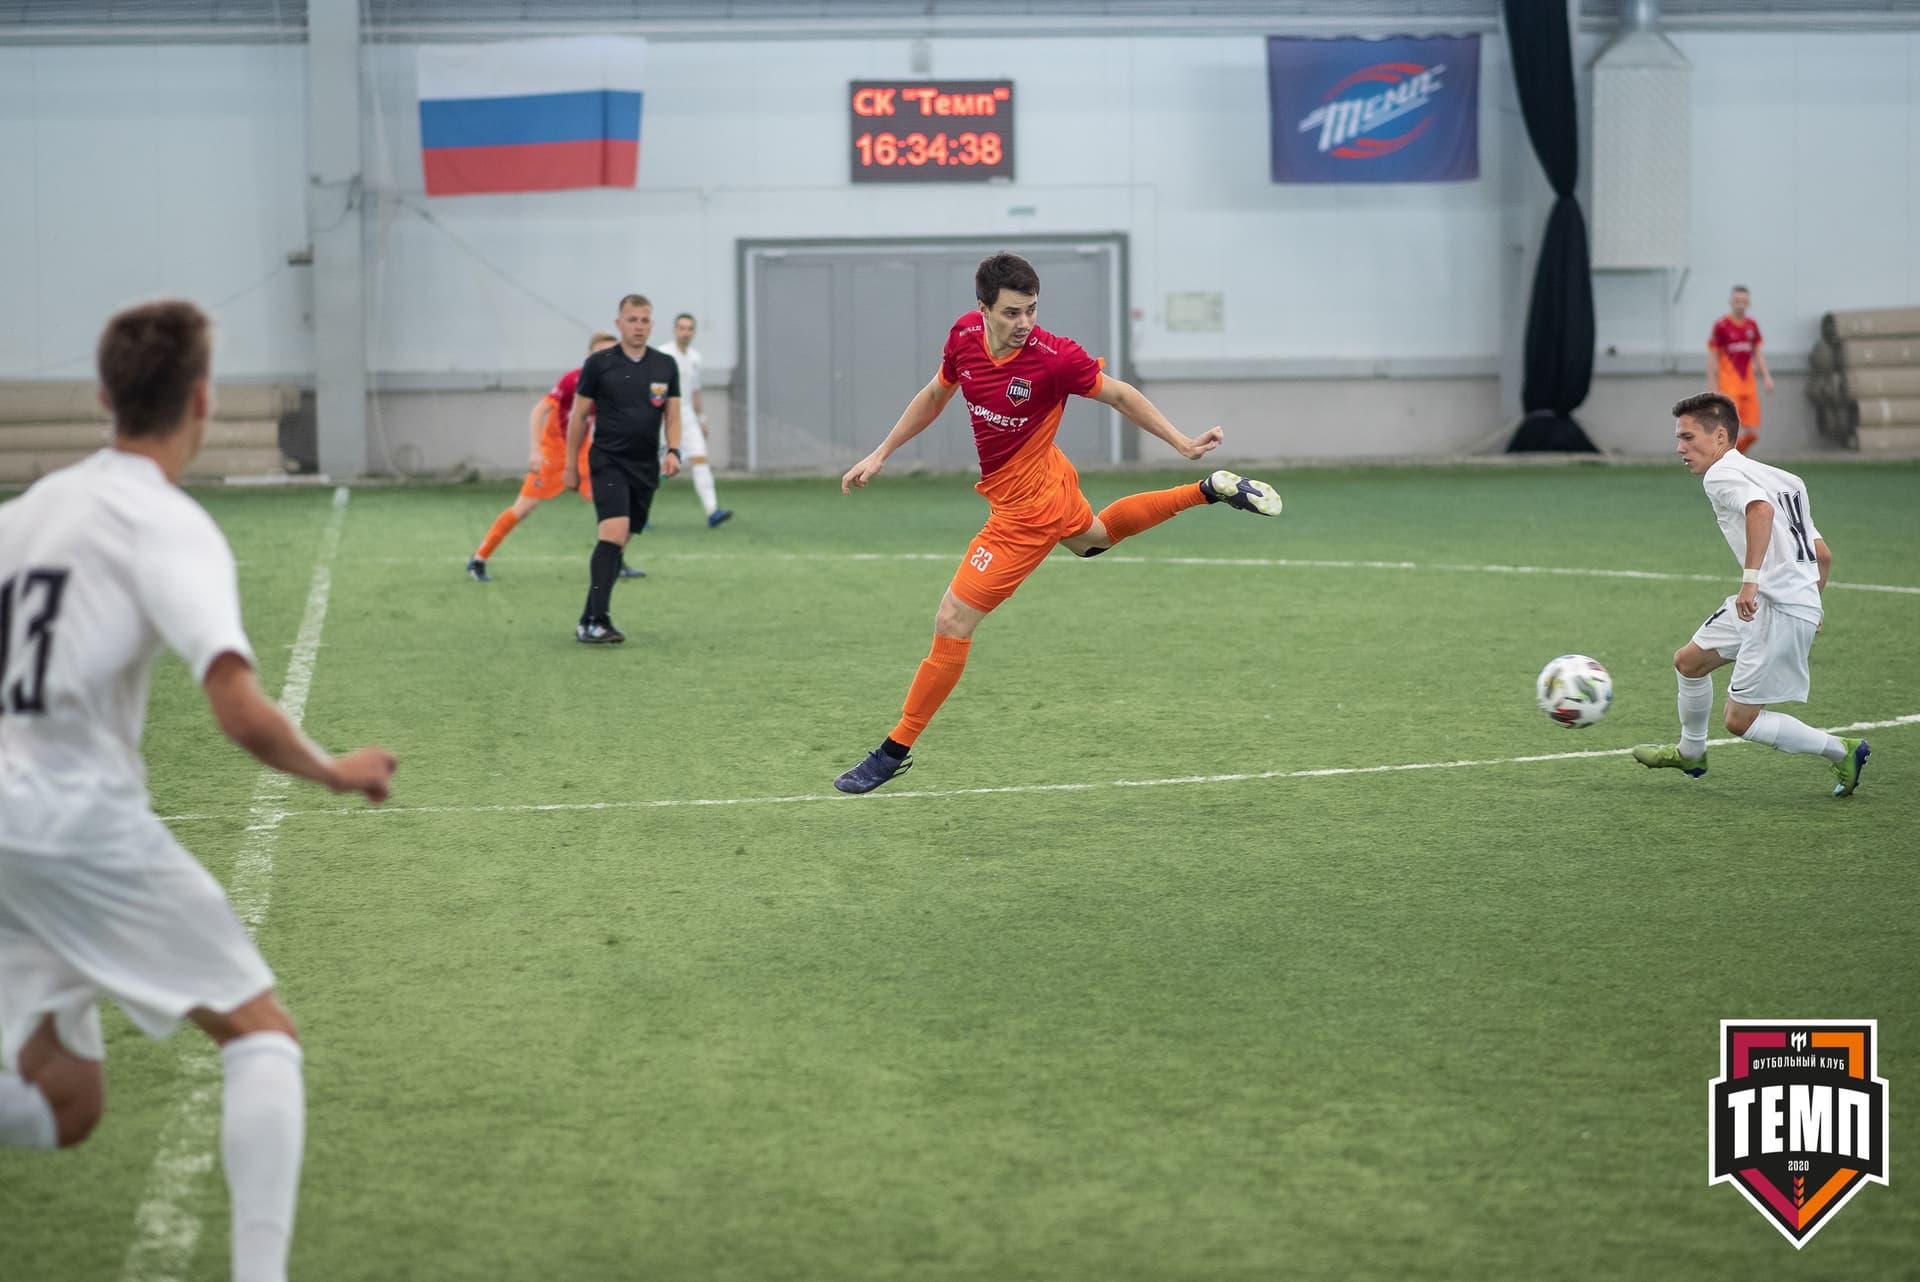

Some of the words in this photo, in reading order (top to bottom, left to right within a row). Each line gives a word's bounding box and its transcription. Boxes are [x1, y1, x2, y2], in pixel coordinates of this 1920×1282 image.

[853, 87, 897, 117] СК
[855, 131, 1004, 166] 16:34:38
[970, 546, 993, 572] 23
